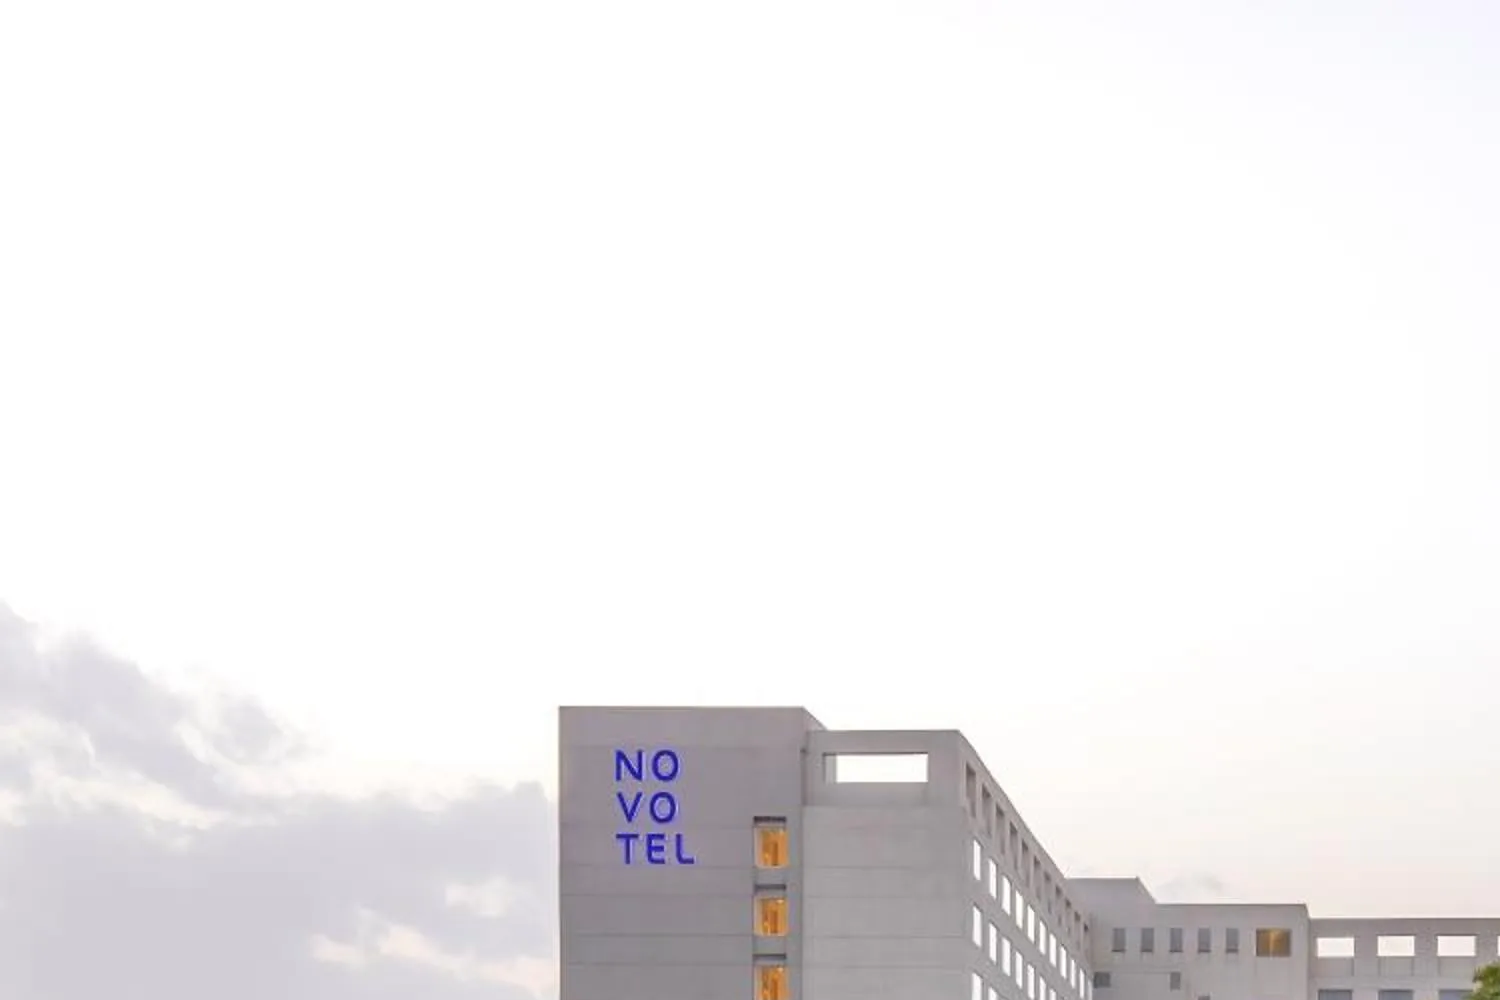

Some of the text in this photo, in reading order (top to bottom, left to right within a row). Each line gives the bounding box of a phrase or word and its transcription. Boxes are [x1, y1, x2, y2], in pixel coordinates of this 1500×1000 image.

[615, 749, 679, 781] NO
[616, 791, 676, 823] VO
[615, 833, 695, 865] TEL
